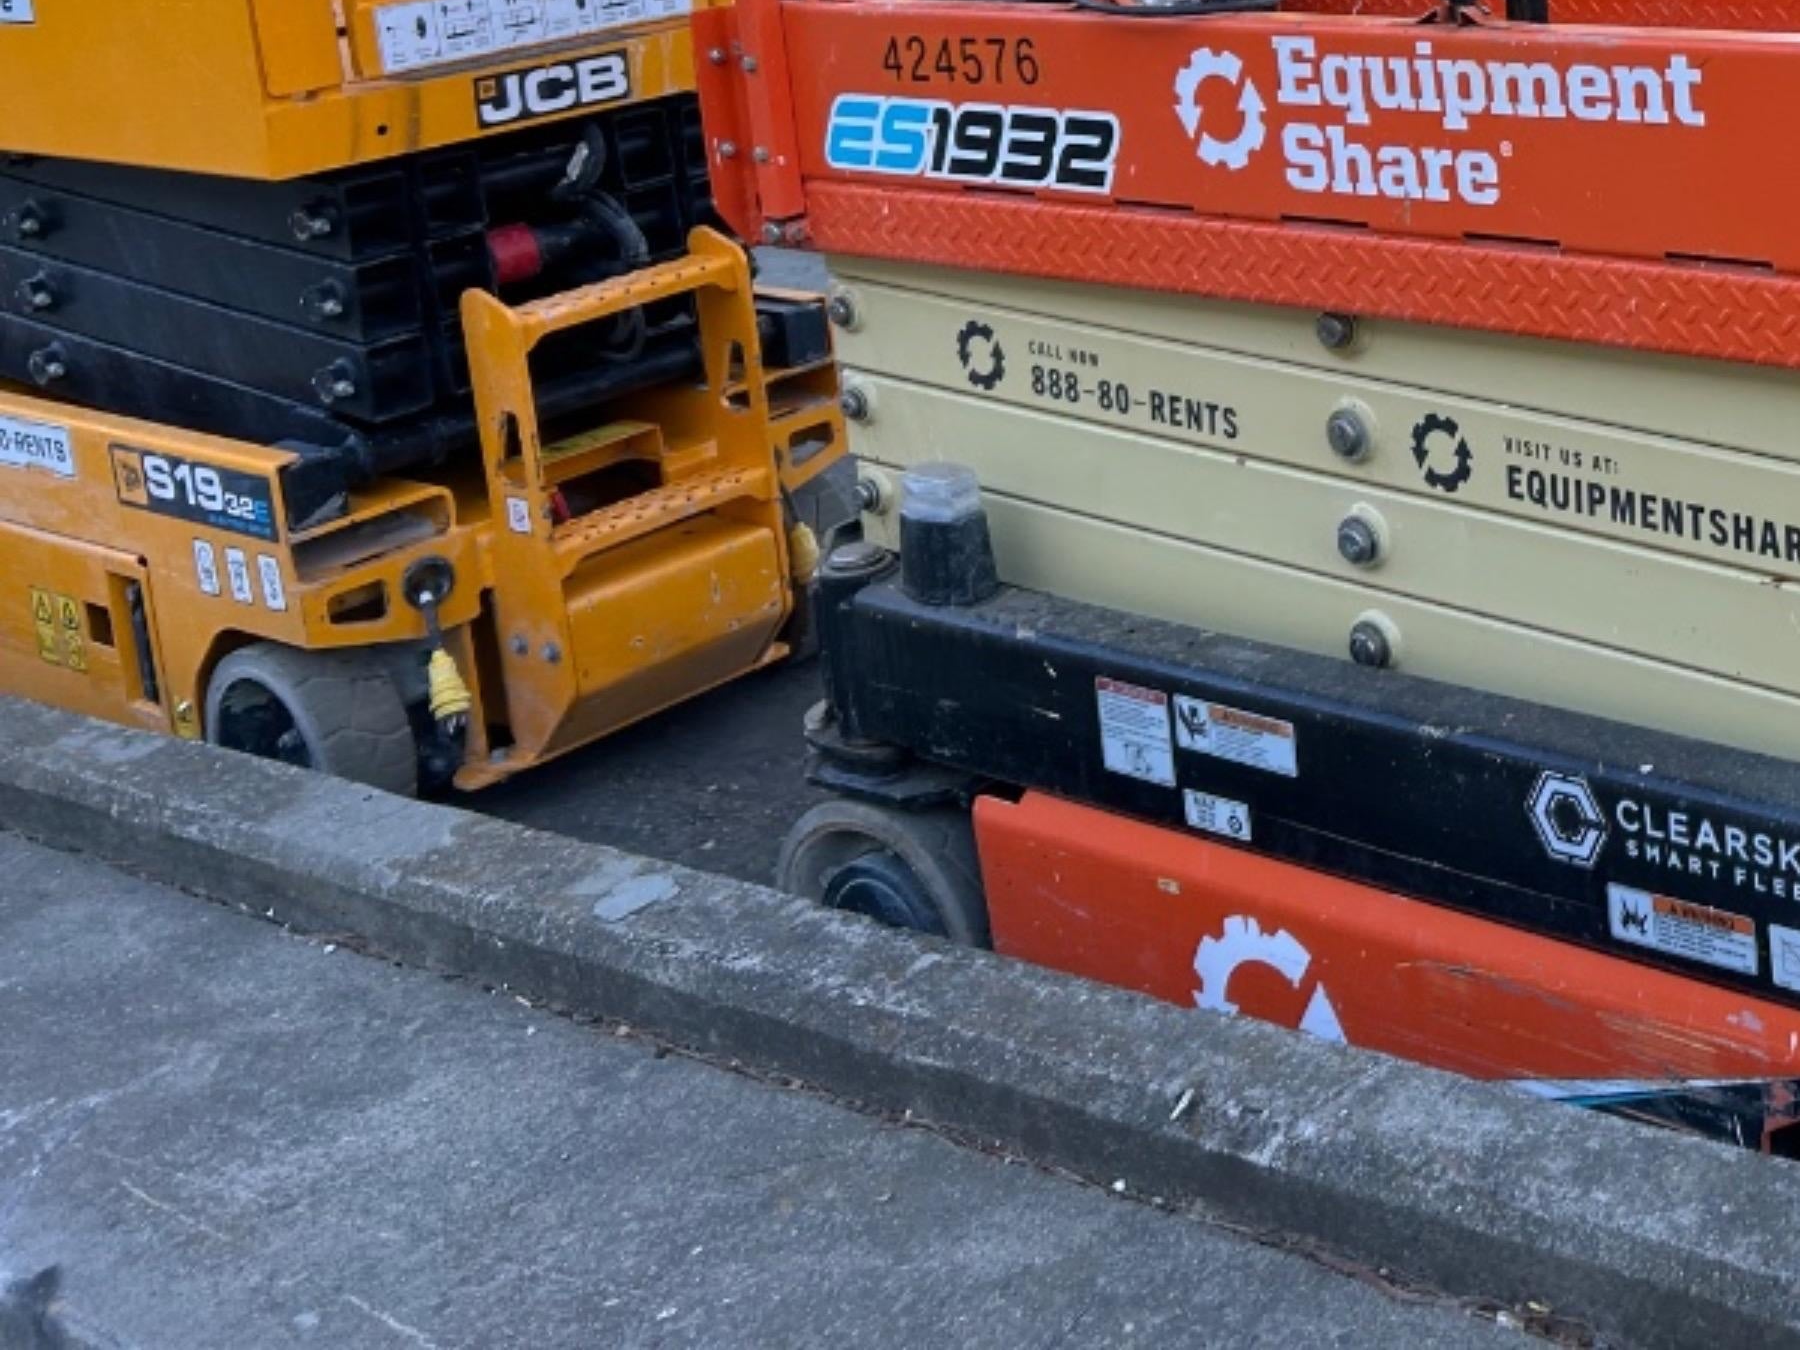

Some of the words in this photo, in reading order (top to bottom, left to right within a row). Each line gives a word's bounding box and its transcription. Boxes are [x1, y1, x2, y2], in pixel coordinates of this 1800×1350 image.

[479, 54, 629, 124] JCB
[882, 35, 1040, 85] 424576
[1272, 35, 1706, 130] Equipment
[827, 93, 1119, 194] ES1932
[1028, 340, 1063, 362] CALL
[1068, 347, 1099, 368] NOW
[1031, 364, 1239, 439] 888-80-RENTS
[1503, 436, 1552, 463] VISIT
[1559, 448, 1583, 468] US
[1625, 838, 1722, 881] SMART
